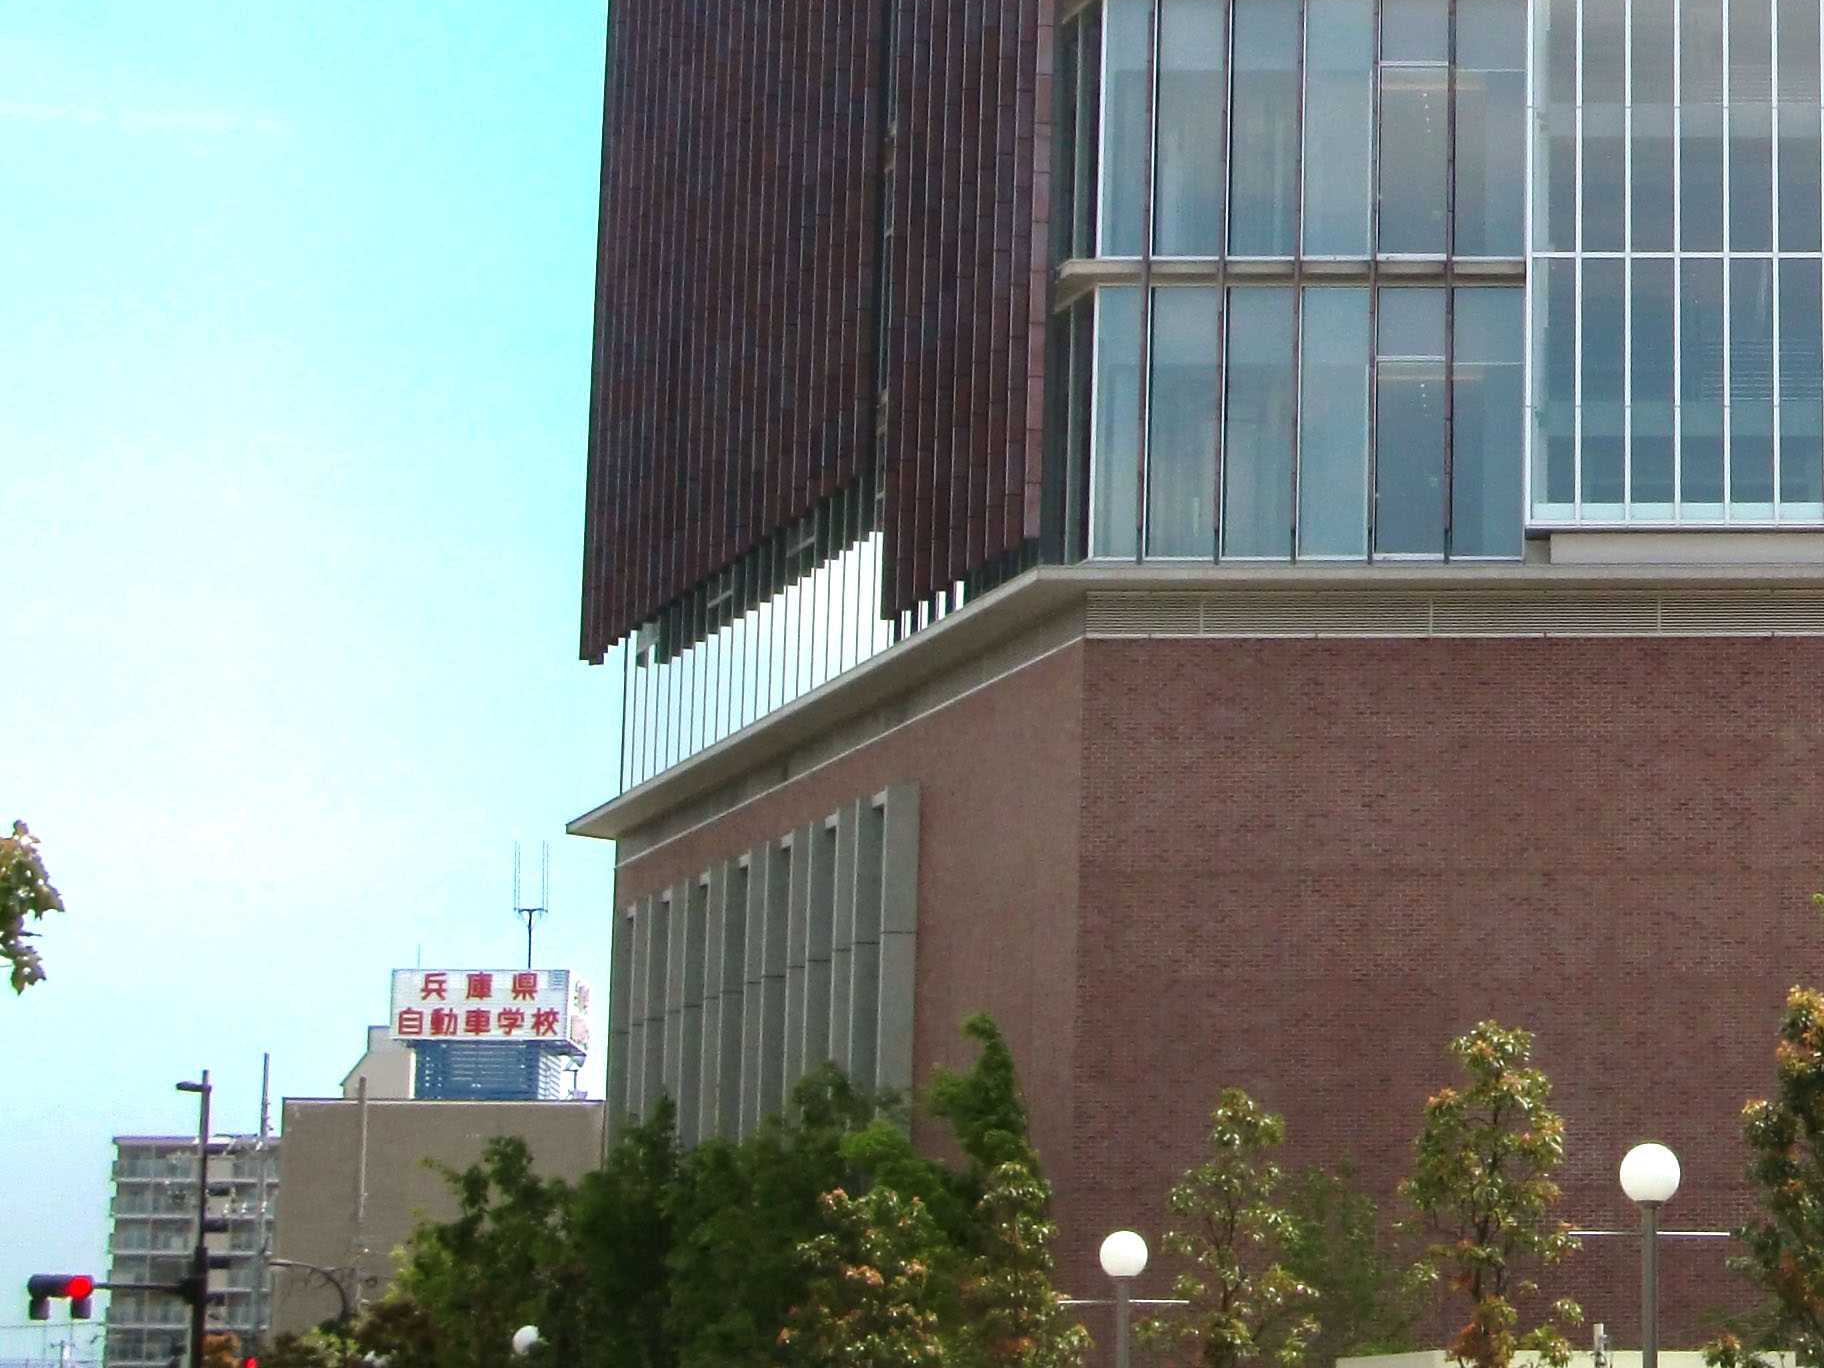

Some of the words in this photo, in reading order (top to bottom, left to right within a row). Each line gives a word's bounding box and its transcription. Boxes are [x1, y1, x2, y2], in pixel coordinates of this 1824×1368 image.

[420, 971, 538, 1001] 兵庫県
[397, 1007, 560, 1036] 自動車学校
